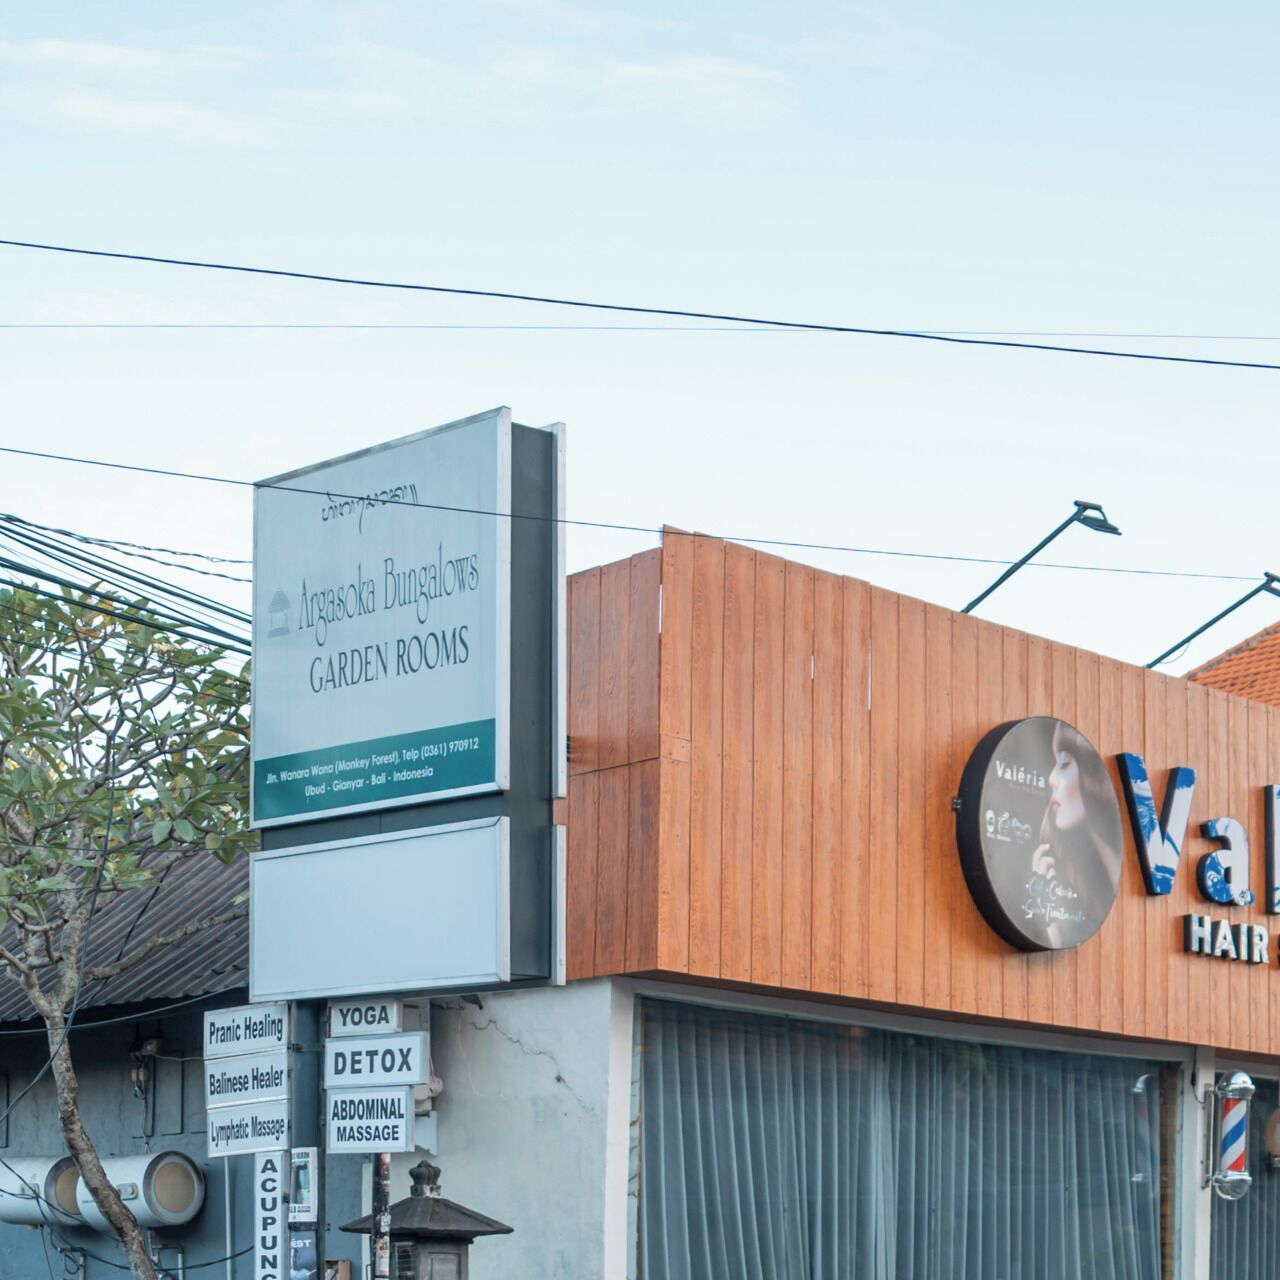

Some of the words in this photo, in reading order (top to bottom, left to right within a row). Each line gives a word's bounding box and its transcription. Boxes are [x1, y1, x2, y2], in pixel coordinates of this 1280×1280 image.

[298, 560, 376, 647] Argasoka
[384, 540, 479, 624] Bungalows
[310, 642, 388, 693] GARDEN
[396, 625, 469, 676] ROOMS
[266, 773, 279, 784] Jln.
[280, 769, 310, 782] Wanara
[311, 764, 334, 776] Wana
[335, 757, 371, 774] (Monkey
[403, 748, 419, 762] Telp
[421, 742, 447, 760] (0361)
[449, 737, 479, 753] 970912
[996, 760, 1045, 788] Valéria
[305, 782, 326, 797] Ubud
[332, 778, 364, 791] Gianyar
[371, 772, 386, 785] Bali
[393, 766, 434, 782] Indonesia
[1183, 913, 1269, 964] HAIR
[209, 1019, 241, 1045] Pranic
[244, 1013, 283, 1041] Healing
[338, 1005, 390, 1026] YOGA
[334, 1048, 412, 1075] DETOX
[209, 1071, 249, 1095] Balinese
[252, 1065, 284, 1090] Healer
[332, 1098, 404, 1121] ABDOMINAL
[211, 1117, 249, 1147] Lymphatic
[251, 1115, 284, 1141] Massage
[337, 1125, 399, 1142] MASSAGE
